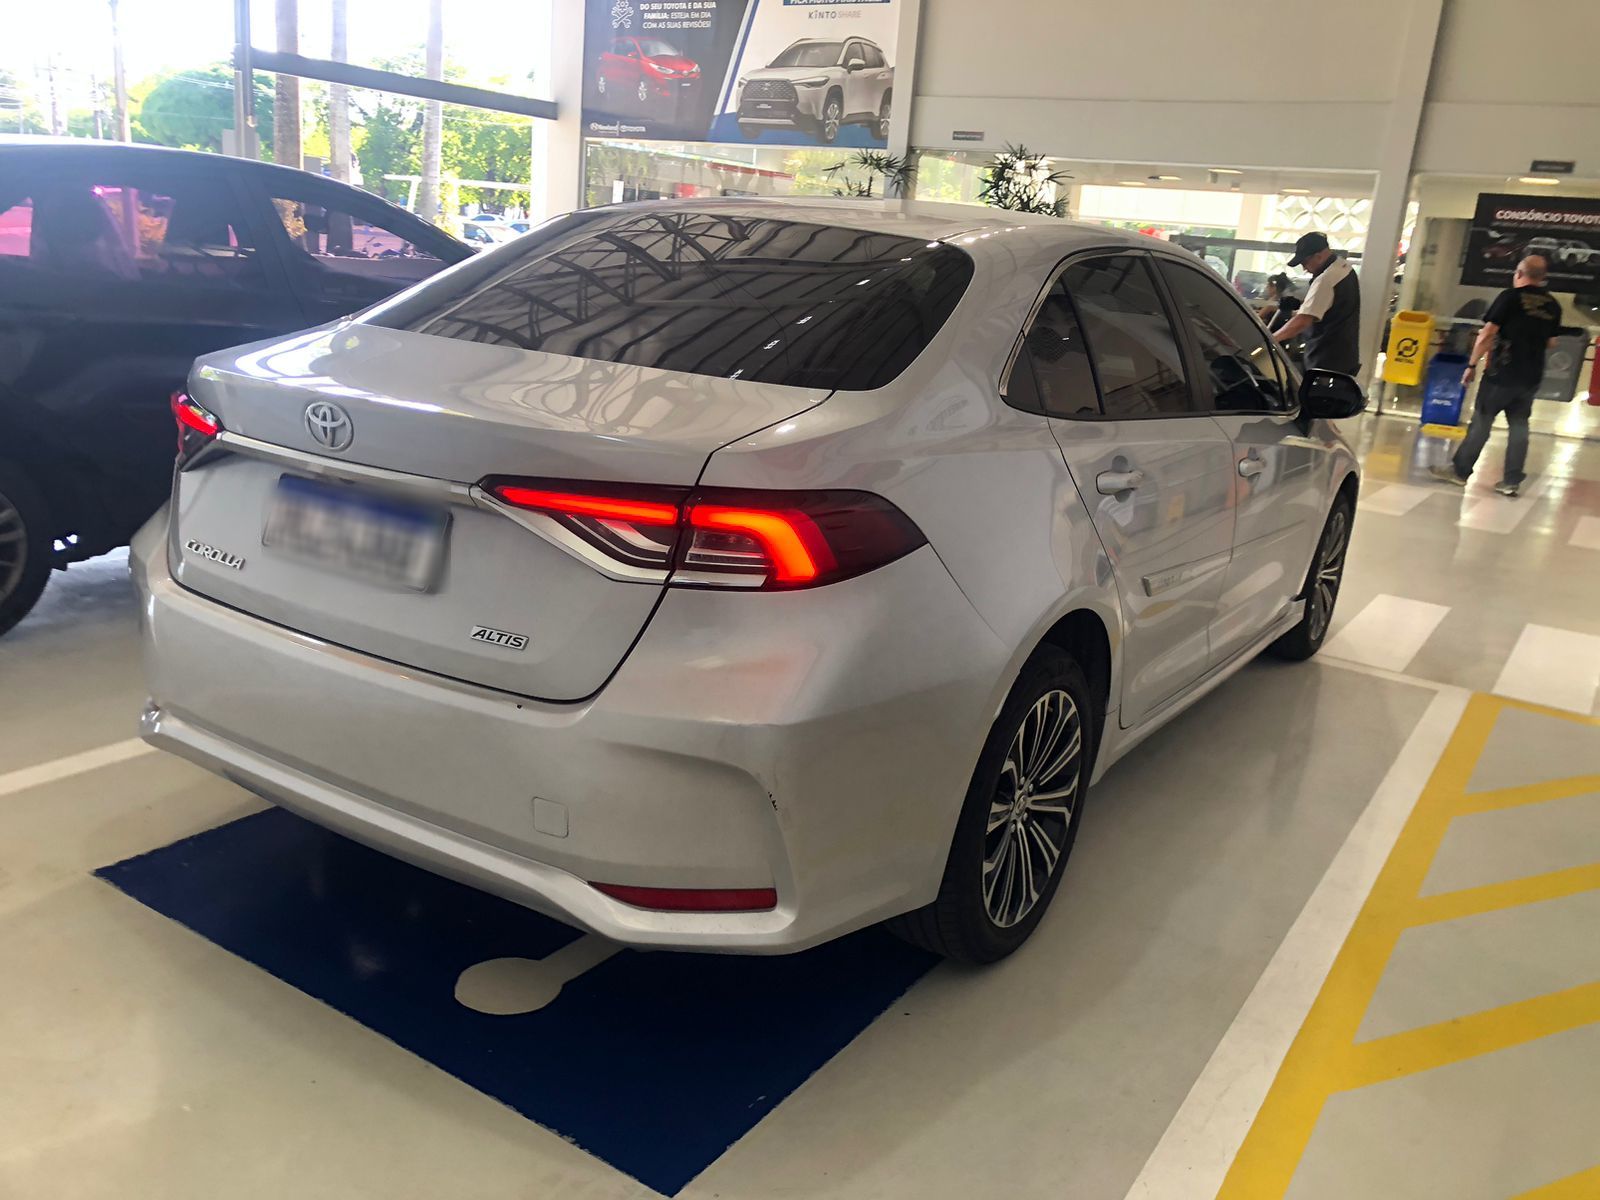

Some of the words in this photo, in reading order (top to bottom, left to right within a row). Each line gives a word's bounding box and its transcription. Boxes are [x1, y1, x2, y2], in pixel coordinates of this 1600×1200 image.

[1495, 208, 1562, 222] CONSÓRCIO
[1563, 213, 1600, 225] TOYOT
[185, 539, 246, 571] COROLLA
[472, 629, 524, 648] ALTIS
